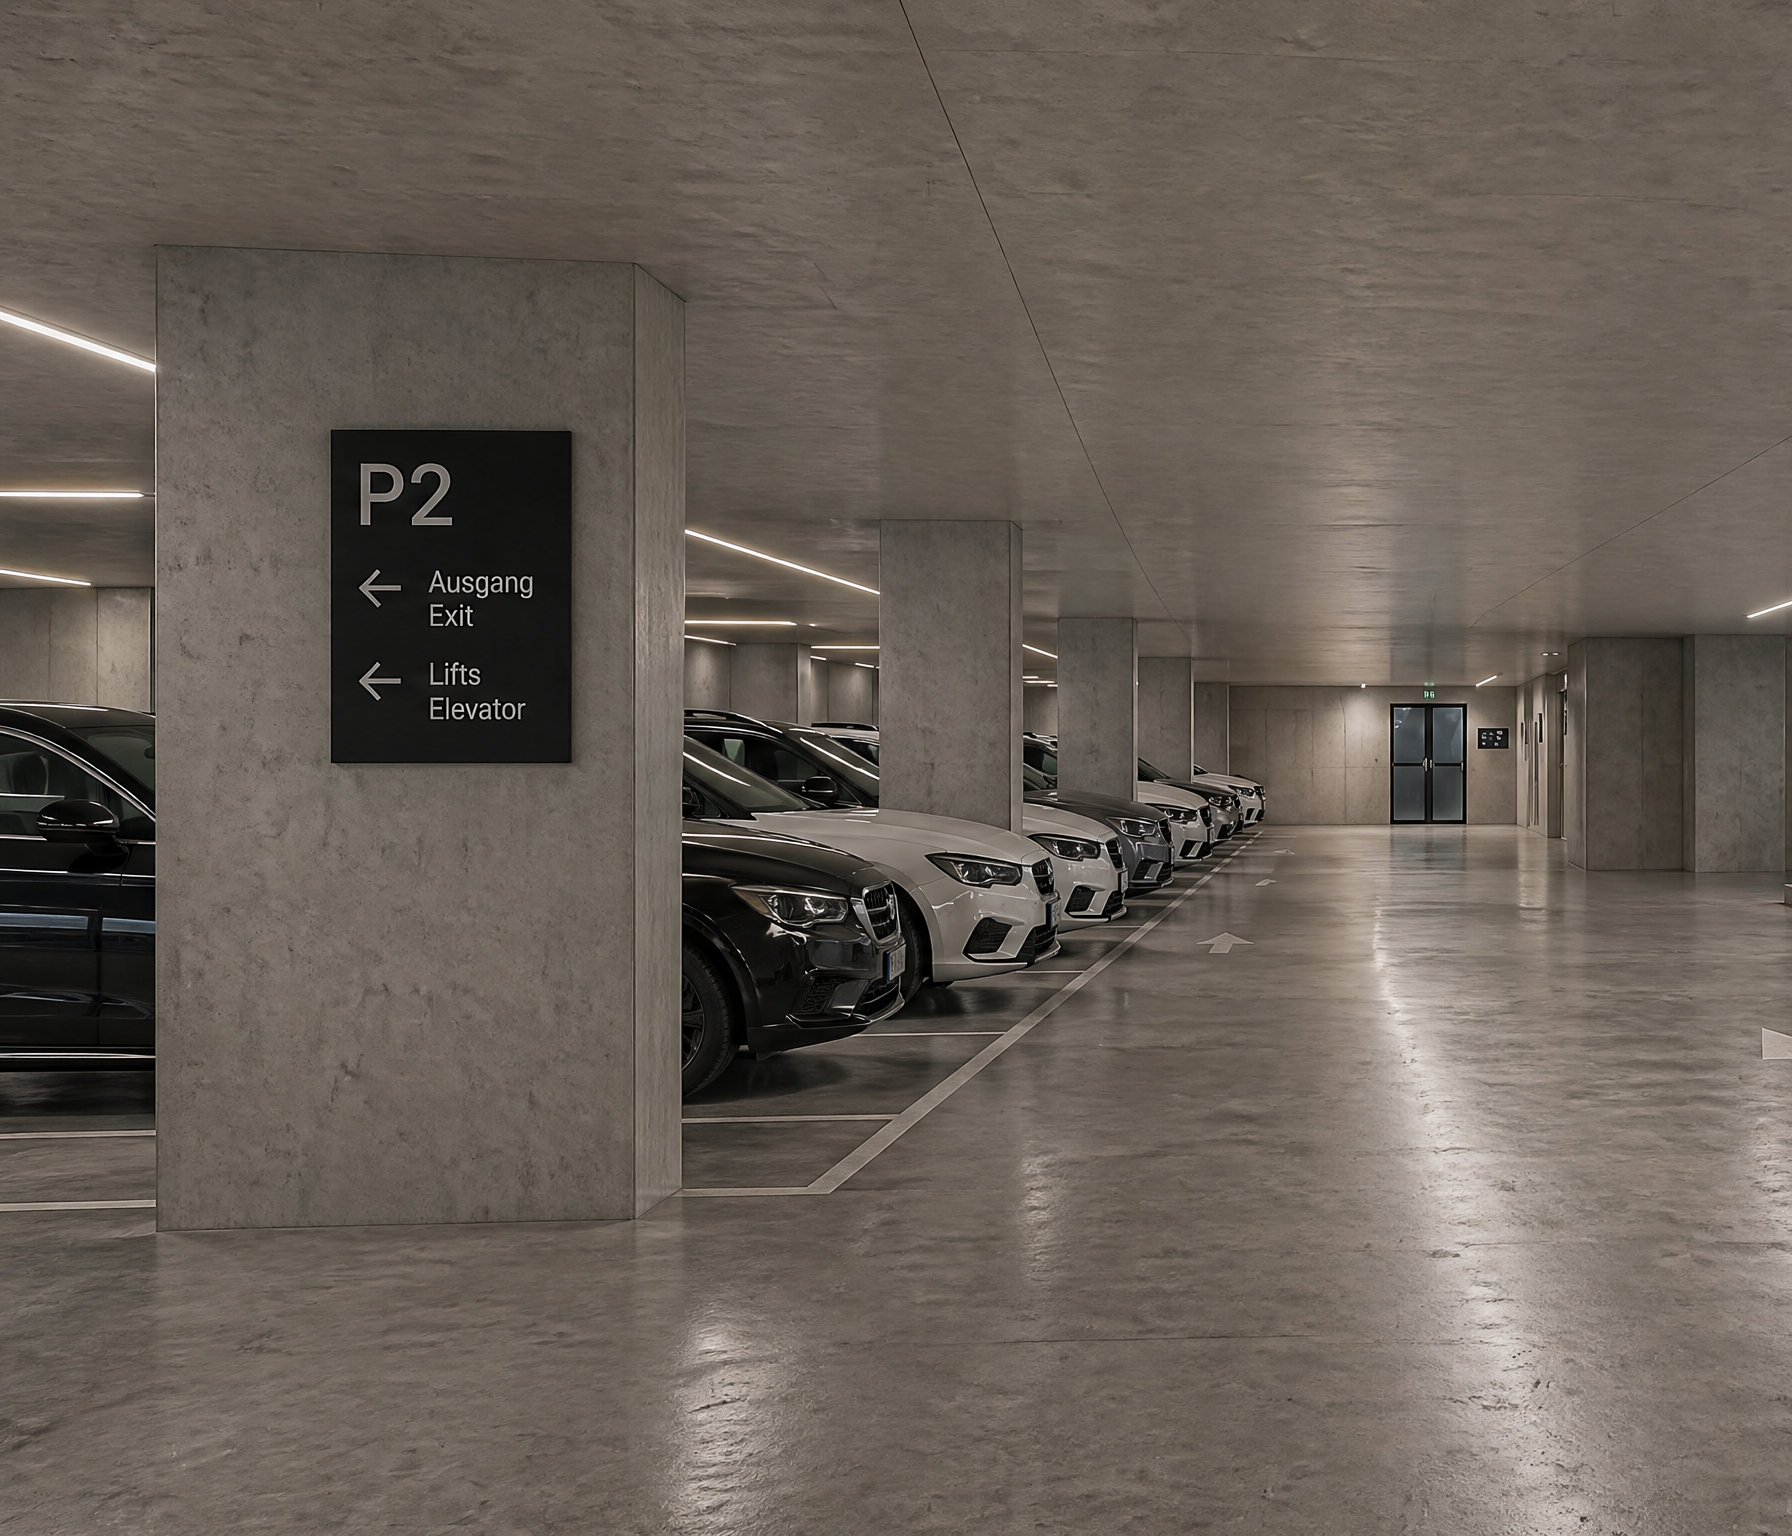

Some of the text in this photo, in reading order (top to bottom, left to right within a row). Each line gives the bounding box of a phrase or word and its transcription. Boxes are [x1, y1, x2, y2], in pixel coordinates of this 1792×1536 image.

[360, 462, 453, 526] P2
[428, 570, 533, 599] Ausgang
[429, 603, 474, 627] Exit
[429, 661, 481, 686] Lifts
[429, 697, 527, 721] Elevator
